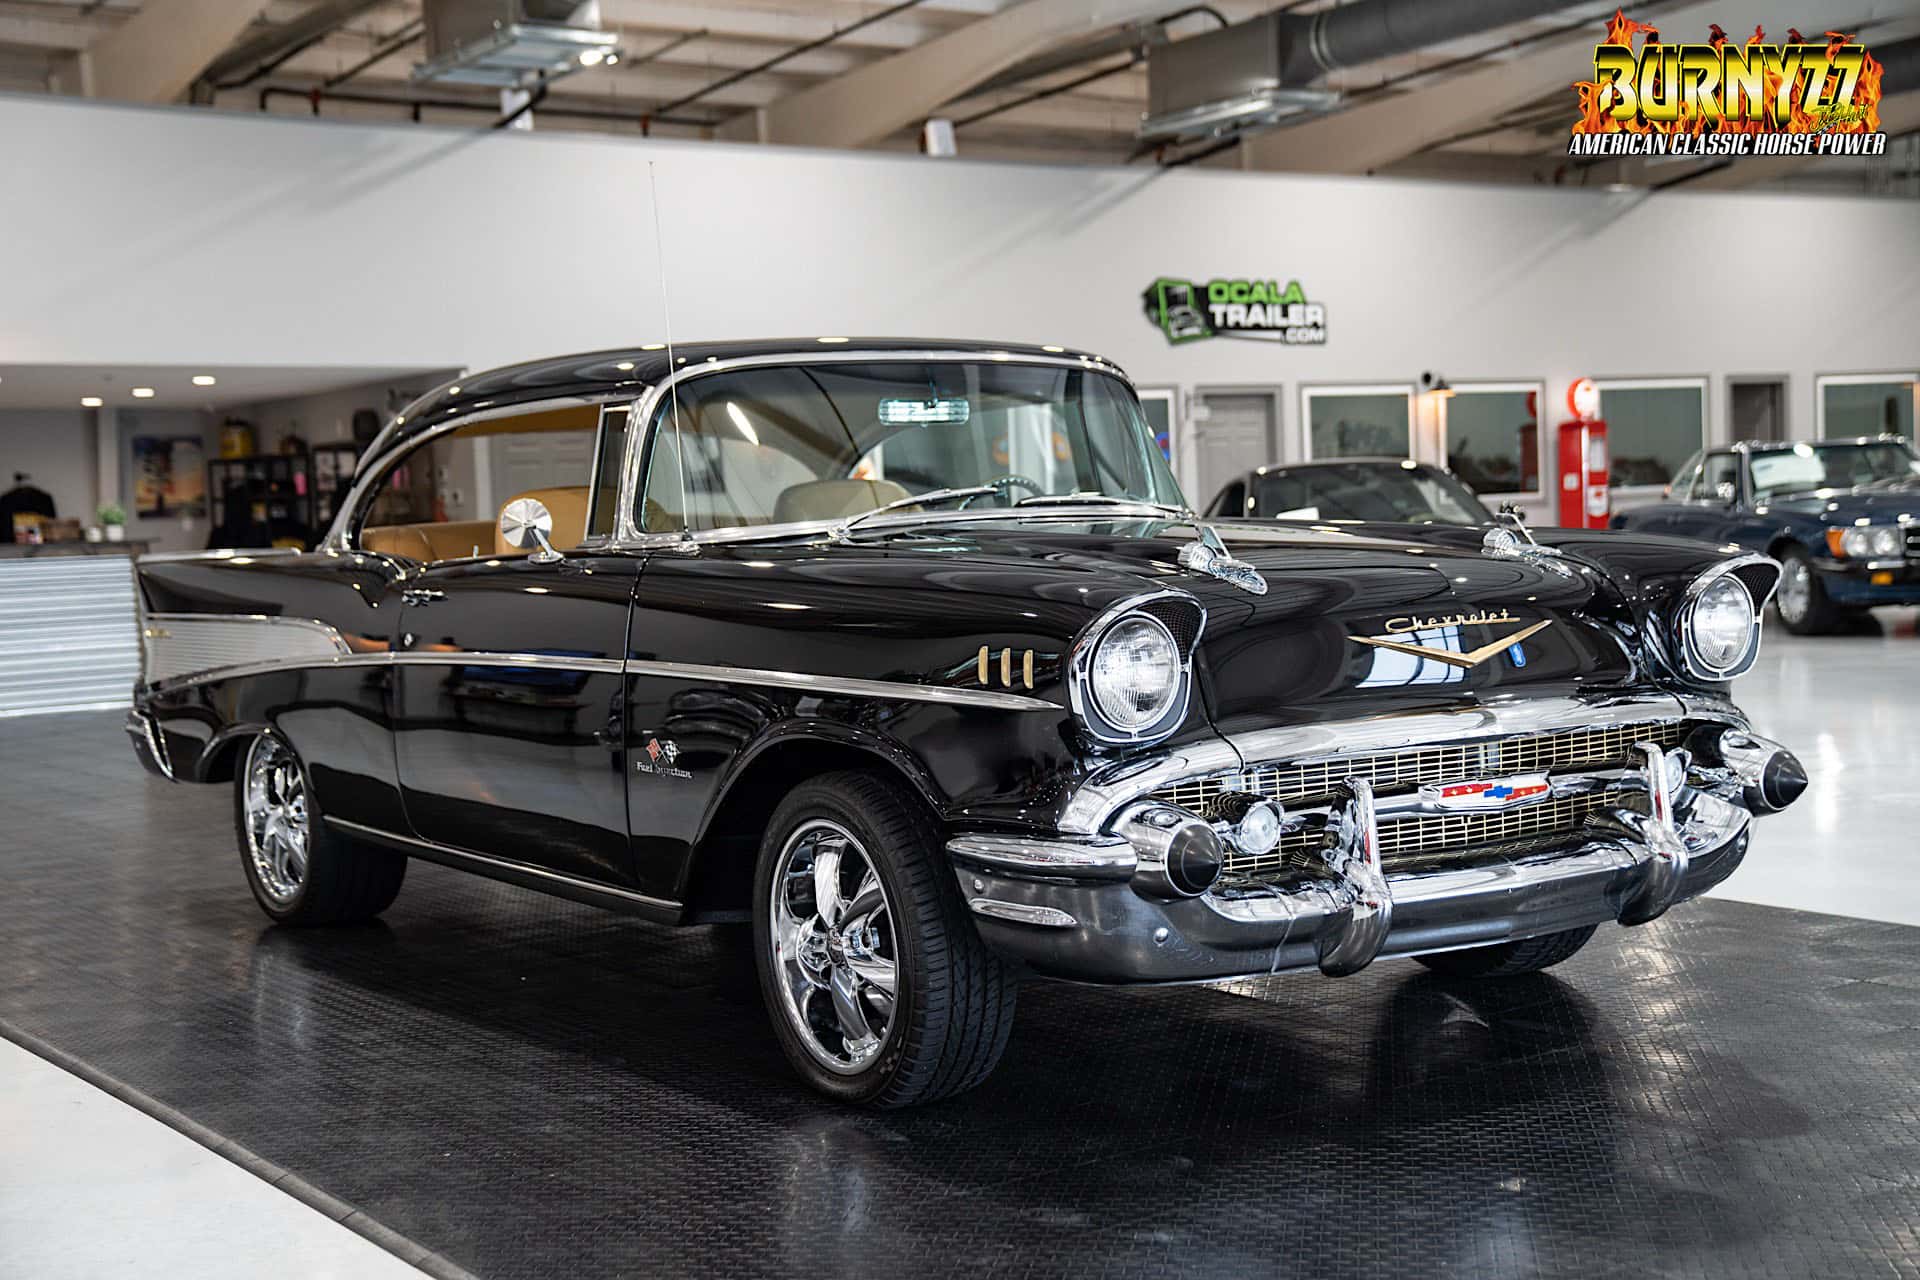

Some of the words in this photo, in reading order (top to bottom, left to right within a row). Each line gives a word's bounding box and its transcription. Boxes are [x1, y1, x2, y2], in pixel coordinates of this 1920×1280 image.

[1208, 281, 1305, 304] OCALA
[1208, 304, 1324, 327] TRAILER
[1385, 608, 1510, 633] Chevrolet
